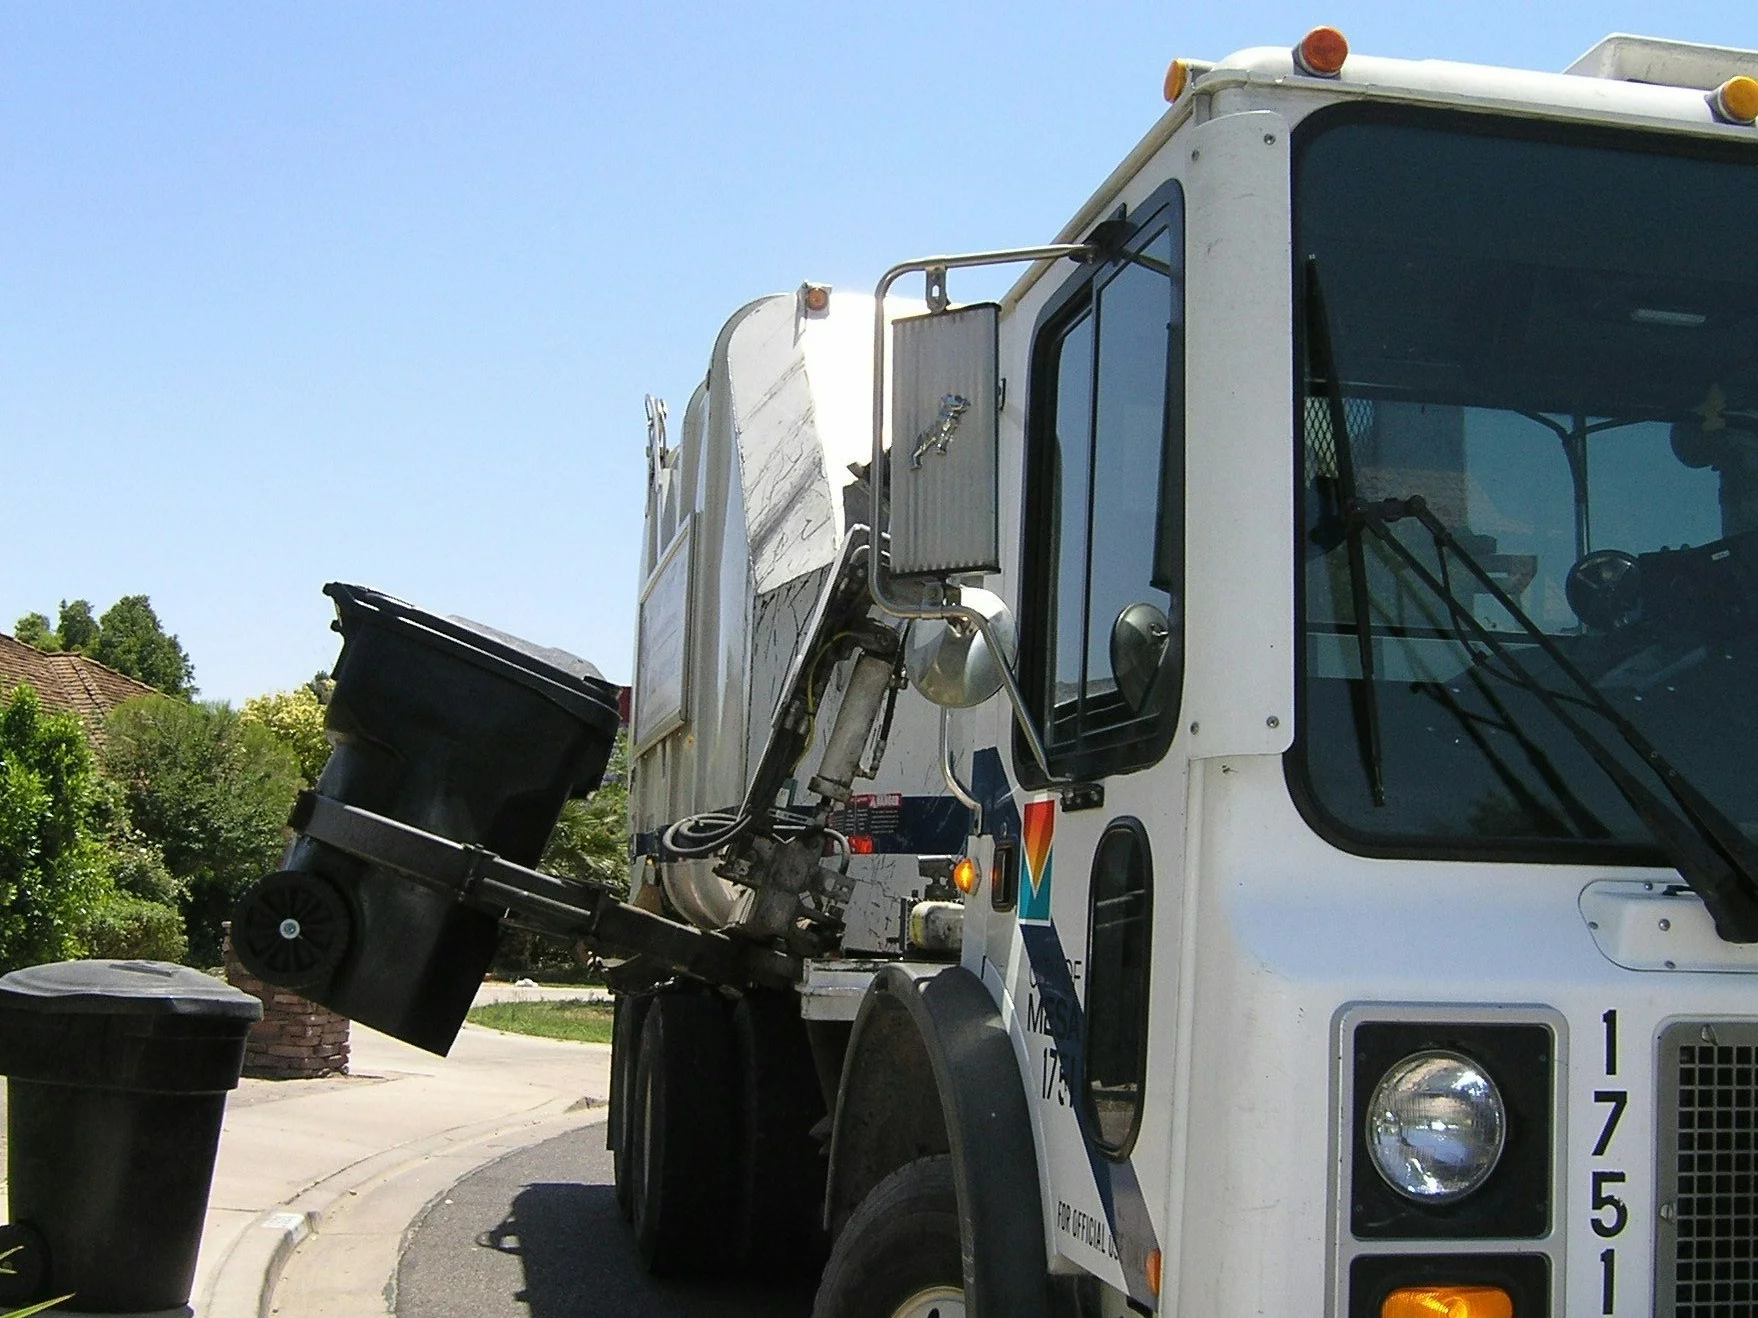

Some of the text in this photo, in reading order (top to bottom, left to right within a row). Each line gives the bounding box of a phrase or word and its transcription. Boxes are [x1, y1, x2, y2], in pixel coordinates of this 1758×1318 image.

[1027, 993, 1081, 1041] MESA
[1590, 1009, 1628, 1316] 1751
[1057, 1200, 1071, 1233] FOR
[1072, 1208, 1105, 1254] OFFICIAL
